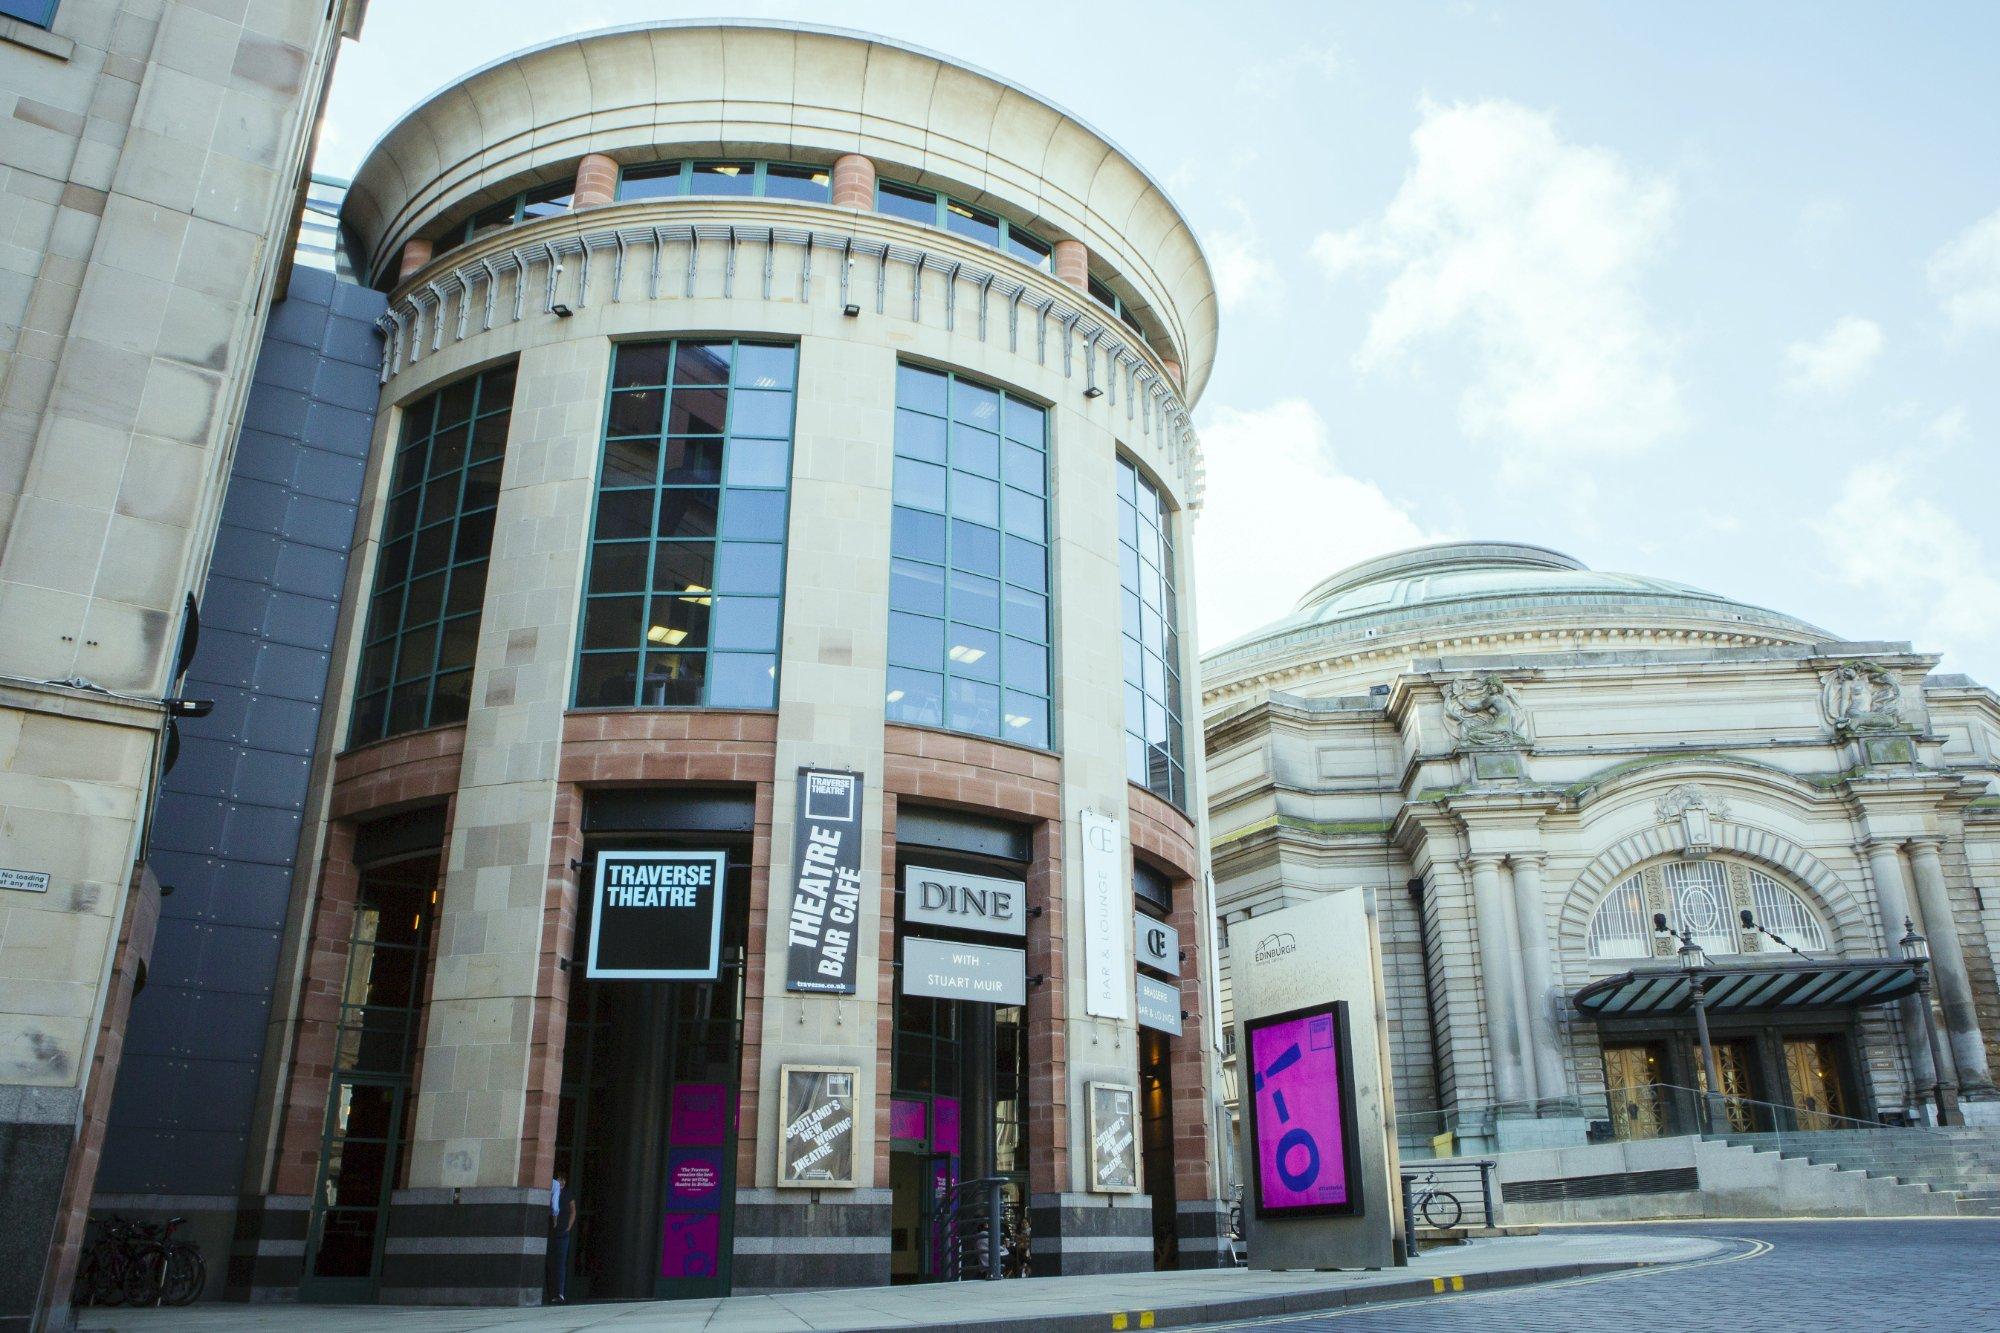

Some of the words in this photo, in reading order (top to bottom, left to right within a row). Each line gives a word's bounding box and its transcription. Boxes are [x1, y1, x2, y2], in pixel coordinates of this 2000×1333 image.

[812, 778, 850, 788] TRAVERSE
[812, 786, 844, 795] THEATRE
[10, 880, 24, 888] any
[16, 874, 45, 882] loading
[610, 865, 711, 886] TRAVERSE
[608, 886, 697, 907] THEATRE
[788, 826, 842, 948] THEATRE
[830, 866, 862, 924] CAFÉ
[920, 880, 1014, 920] DINE
[1098, 870, 1112, 941] LOUNGE
[817, 929, 851, 978] BAR
[952, 954, 980, 966] WITH
[1102, 950, 1112, 960] &
[1255, 944, 1296, 962] EDINBURGH
[927, 974, 970, 990] STUART
[974, 979, 1003, 992] MUIR
[1103, 968, 1112, 1000] BAR
[786, 1100, 841, 1139] SCOTLAND'S
[800, 1122, 824, 1142] NEW
[1103, 1135, 1117, 1154] NEW
[792, 1142, 834, 1173] THEATRE
[1099, 1155, 1123, 1180] THEATRE
